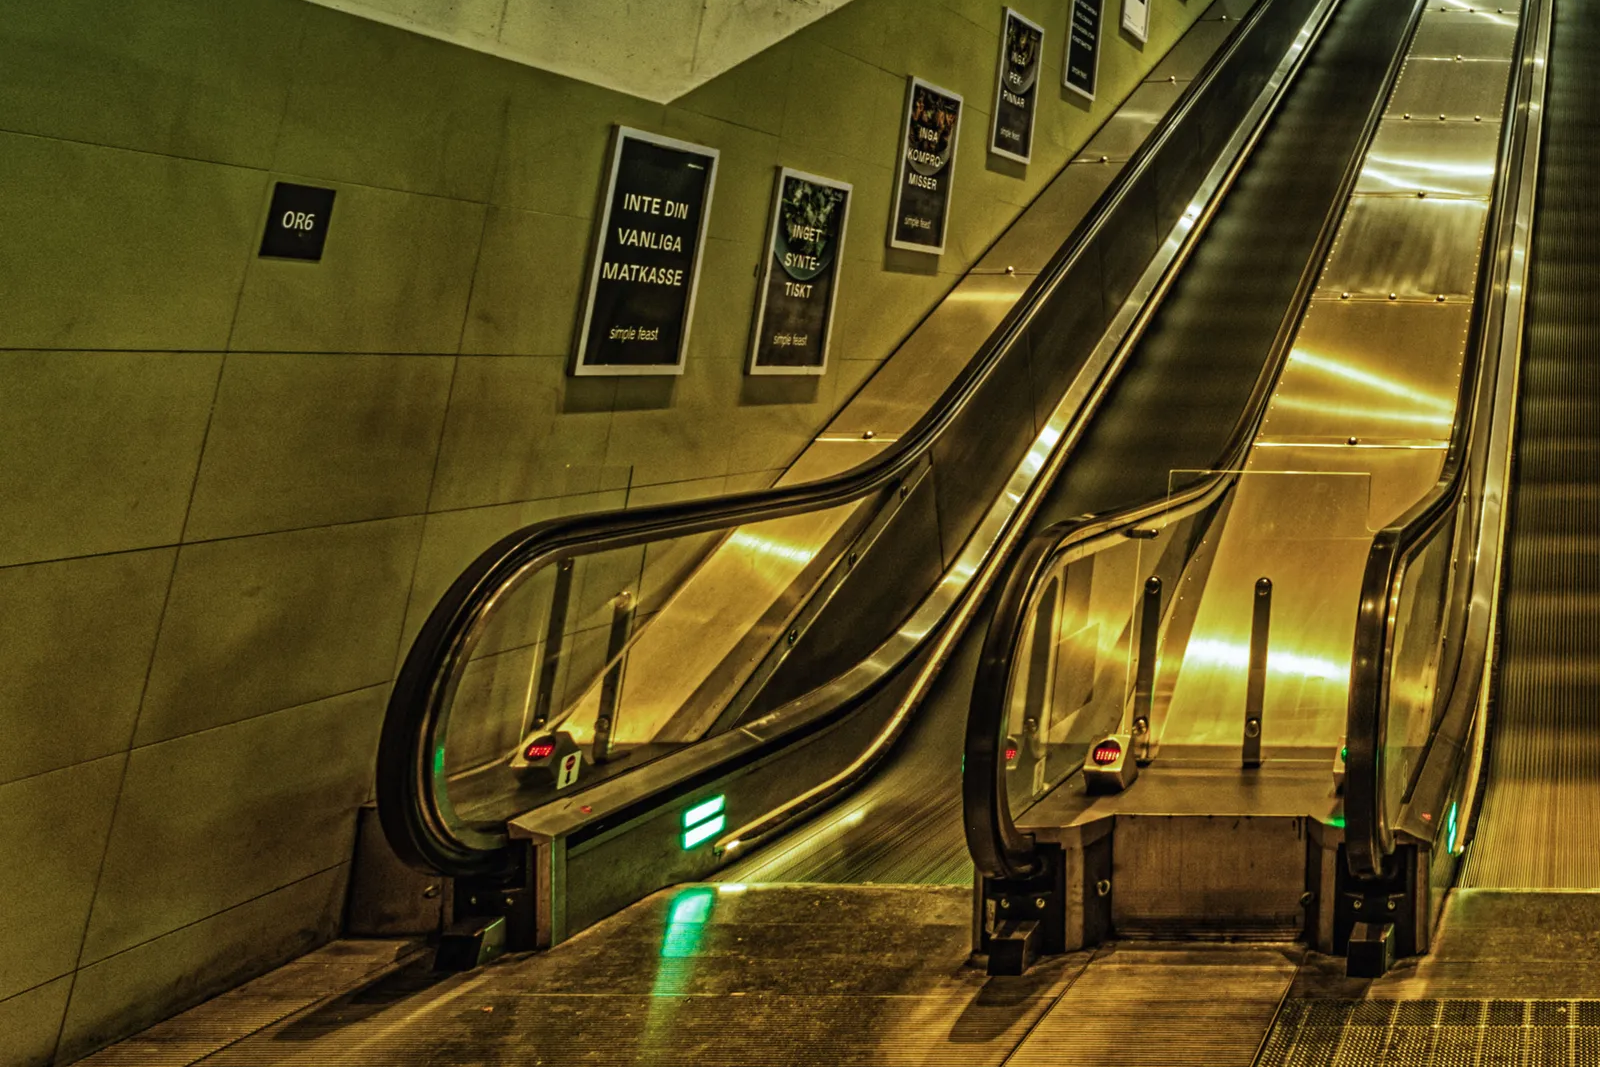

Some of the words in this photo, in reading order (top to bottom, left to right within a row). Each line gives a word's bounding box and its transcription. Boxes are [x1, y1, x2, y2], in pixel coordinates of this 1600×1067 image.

[919, 127, 939, 143] INGA
[907, 147, 944, 168] KOMPRO-
[908, 172, 938, 191] MISSER
[623, 193, 661, 215] INTE
[664, 200, 689, 220] DIN
[282, 210, 315, 231] OR6
[618, 227, 682, 253] VANLIGA
[792, 224, 823, 243] INGET
[784, 252, 820, 271] SYNTE-
[602, 262, 683, 286] MATKASSE
[785, 282, 813, 299] TISKT
[609, 324, 636, 343] simple
[637, 326, 659, 341] feast
